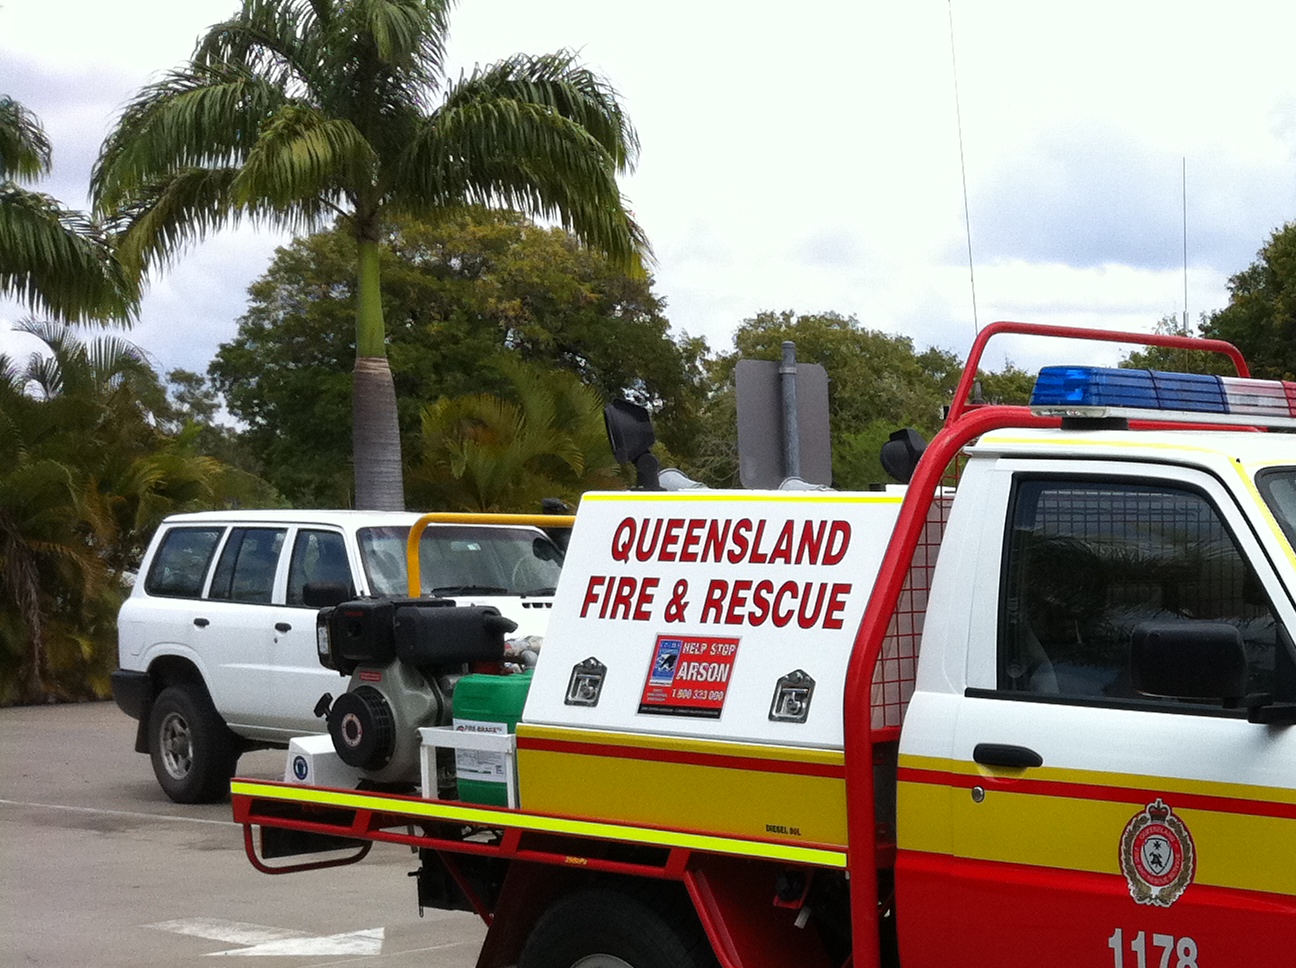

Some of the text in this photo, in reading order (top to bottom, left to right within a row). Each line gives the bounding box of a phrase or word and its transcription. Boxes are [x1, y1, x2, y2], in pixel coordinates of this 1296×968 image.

[611, 517, 852, 565] QUEENSLAND
[579, 575, 853, 630] FIRE & RESCUE
[682, 642, 708, 655] HELP
[710, 643, 737, 656] STOP
[675, 661, 730, 683] ARSON
